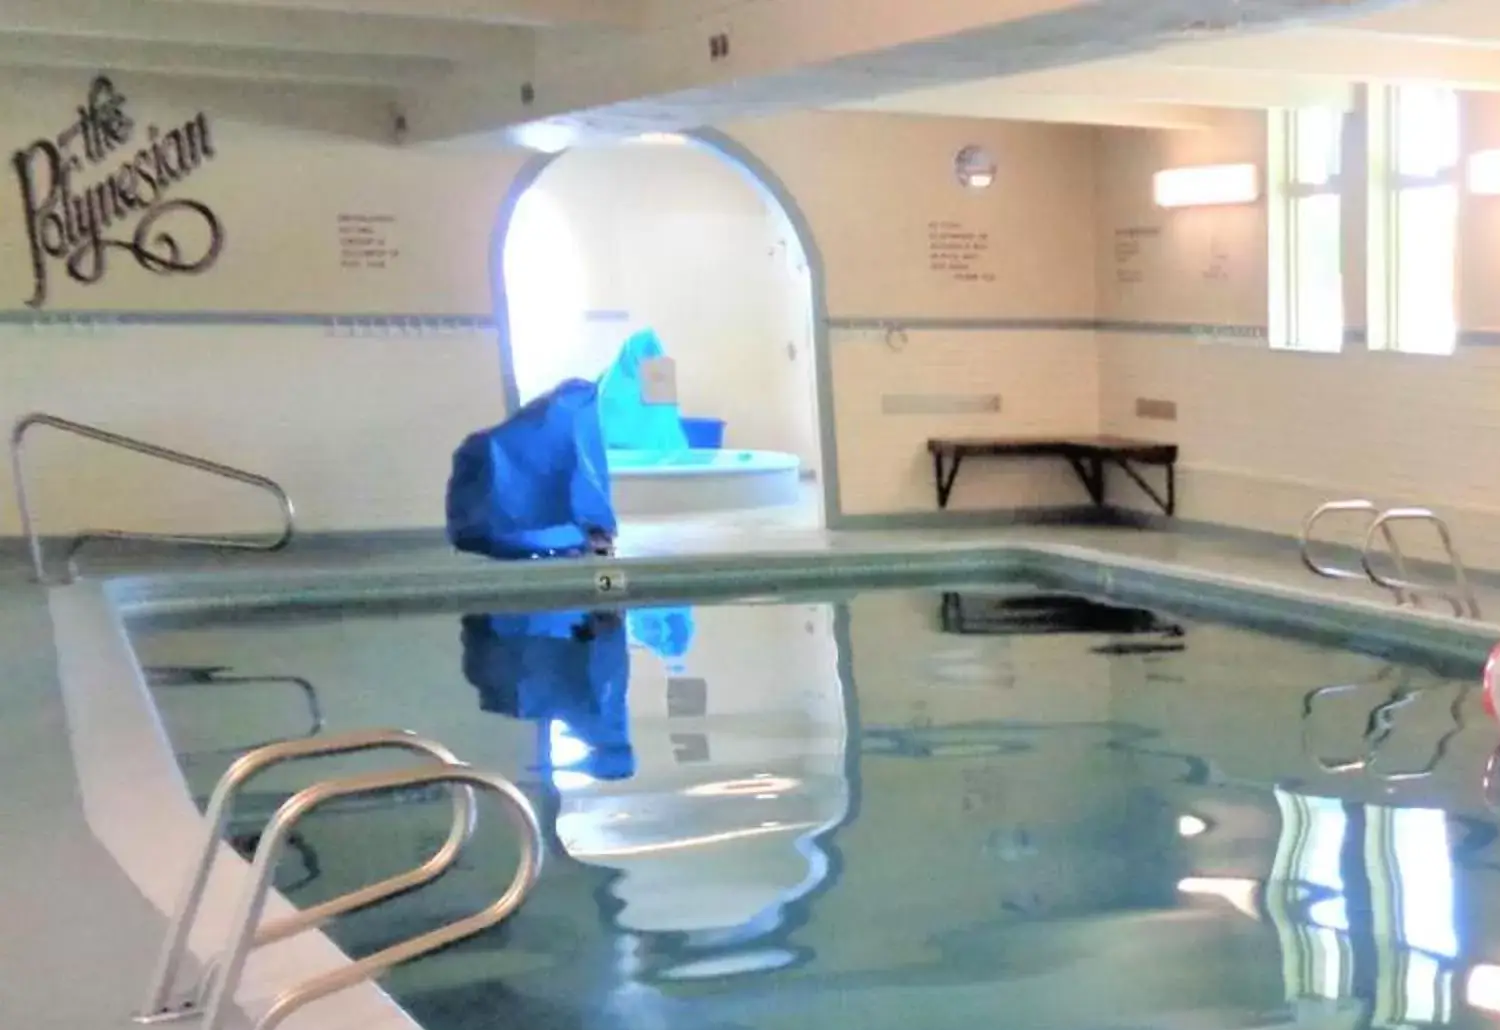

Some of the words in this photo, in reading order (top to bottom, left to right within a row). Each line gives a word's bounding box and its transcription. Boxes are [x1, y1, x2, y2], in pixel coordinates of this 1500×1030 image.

[57, 76, 134, 162] the
[12, 111, 223, 308] Polynesian
[599, 575, 612, 592] 3
